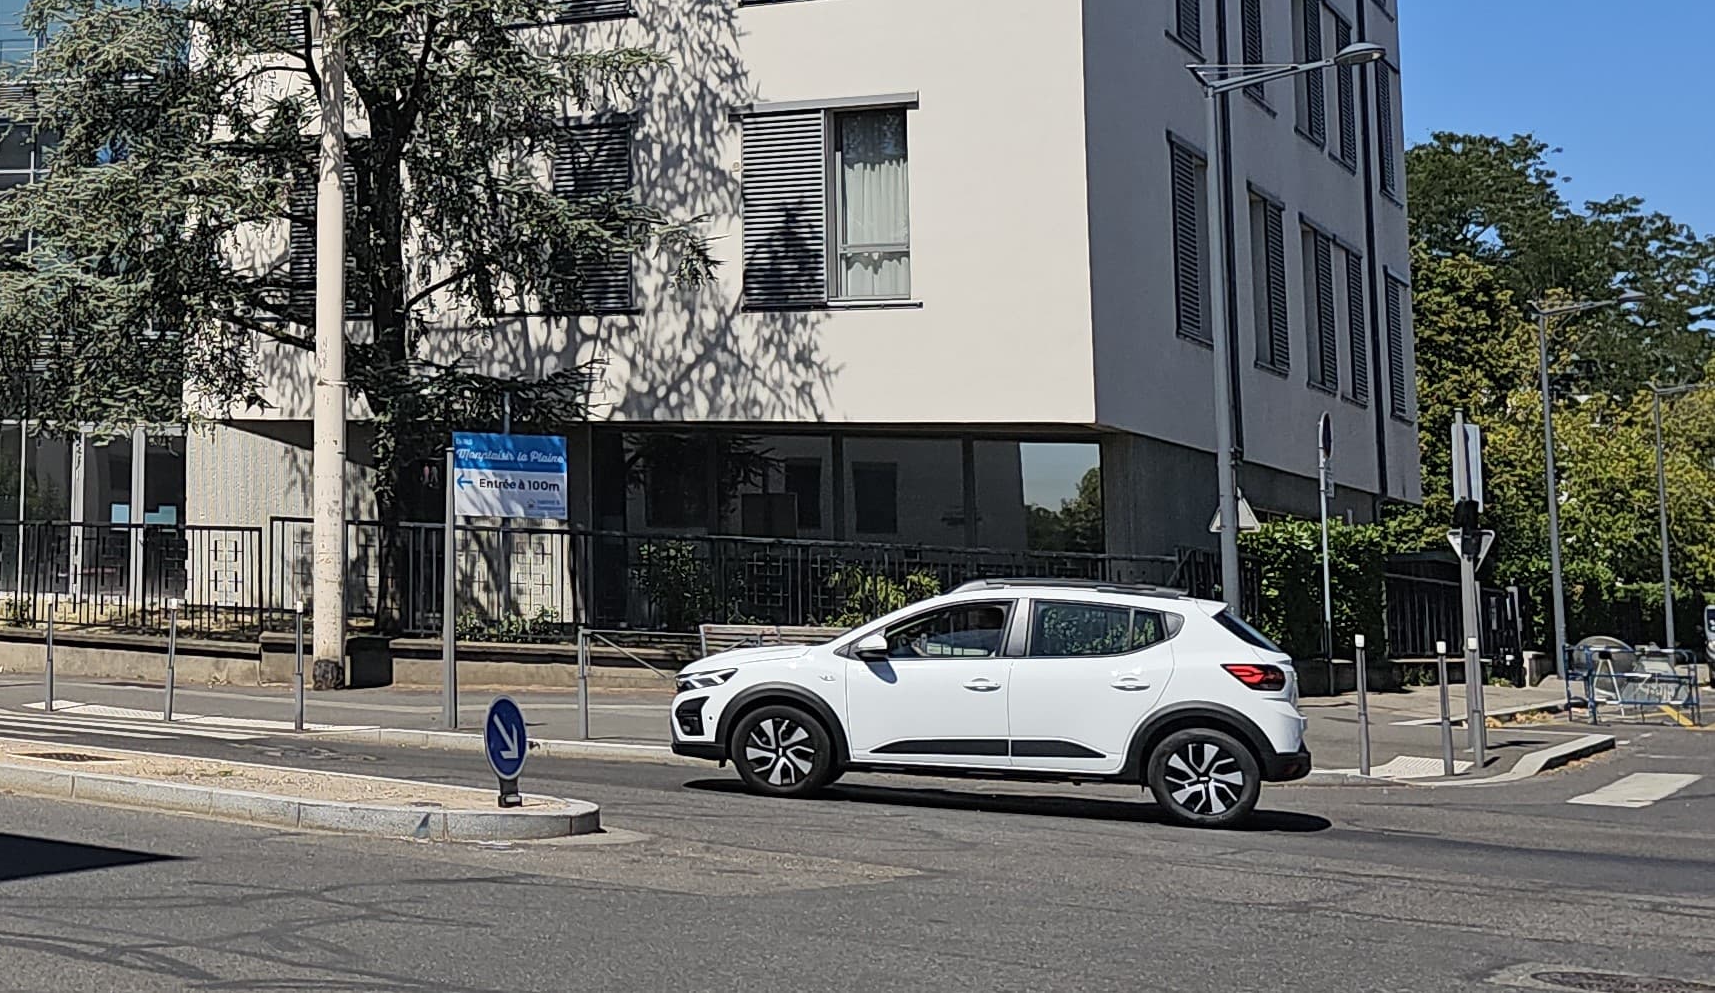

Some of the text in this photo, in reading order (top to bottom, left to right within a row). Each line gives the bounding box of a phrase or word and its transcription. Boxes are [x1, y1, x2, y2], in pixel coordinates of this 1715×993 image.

[479, 478, 560, 492] Entrée à 100m
